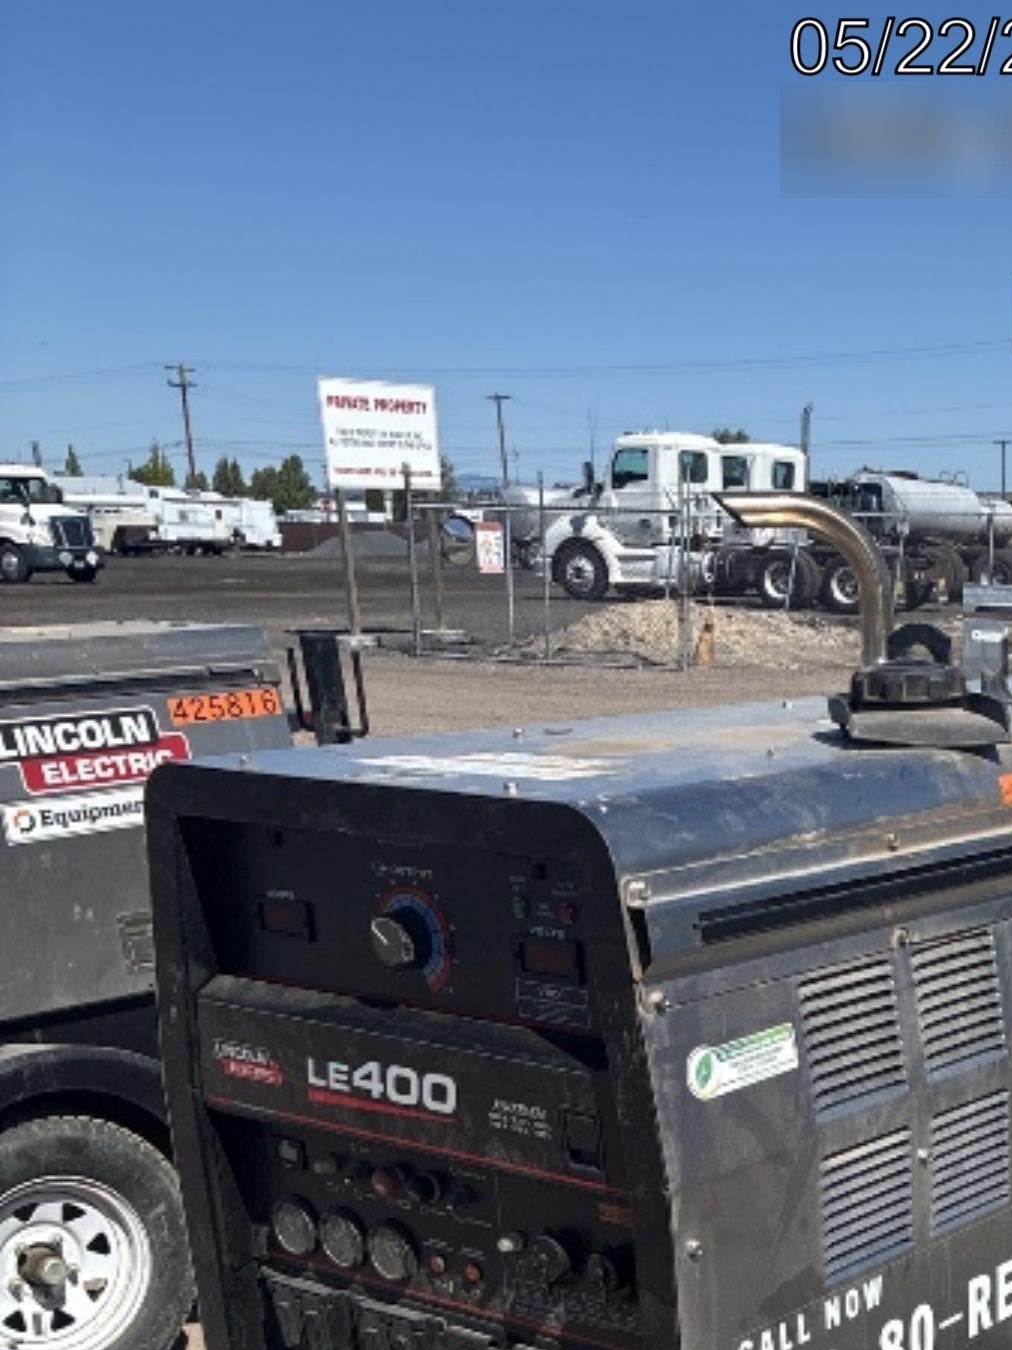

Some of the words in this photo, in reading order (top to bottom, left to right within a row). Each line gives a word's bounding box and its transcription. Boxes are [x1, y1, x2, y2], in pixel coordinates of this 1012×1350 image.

[172, 690, 277, 721] 425816
[0, 714, 150, 757] LINCOLN
[308, 1058, 457, 1114] LE400
[824, 1275, 884, 1330] NOW
